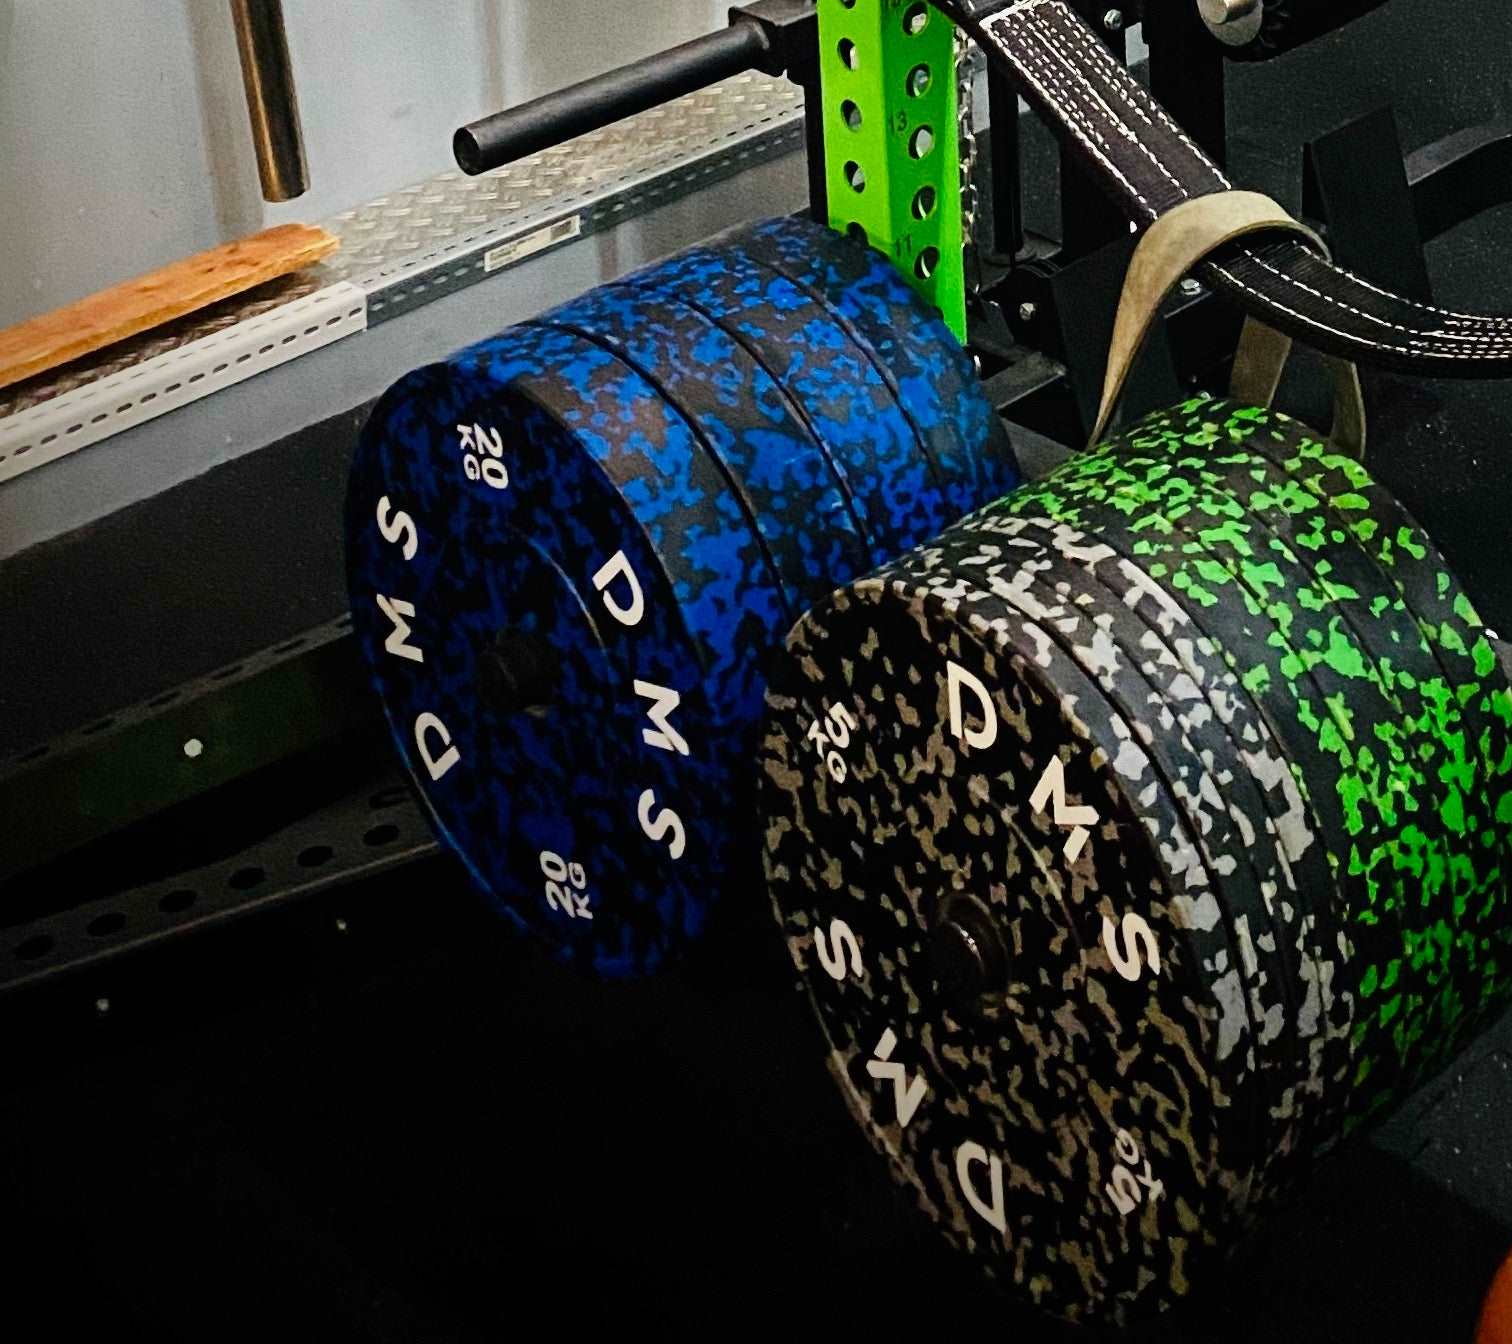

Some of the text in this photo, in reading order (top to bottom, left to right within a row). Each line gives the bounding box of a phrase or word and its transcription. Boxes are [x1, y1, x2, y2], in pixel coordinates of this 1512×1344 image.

[456, 422, 482, 483] KG
[473, 425, 509, 491] 20
[376, 495, 462, 783] DMS
[592, 549, 690, 862] DMS
[828, 700, 856, 750] 5
[806, 723, 849, 785] KG
[946, 660, 1162, 984] DMS
[538, 849, 572, 913] 20
[562, 861, 595, 920] KG
[814, 918, 1002, 1233] DMS
[1104, 1164, 1140, 1216] 5
[1113, 1126, 1165, 1204] KG
